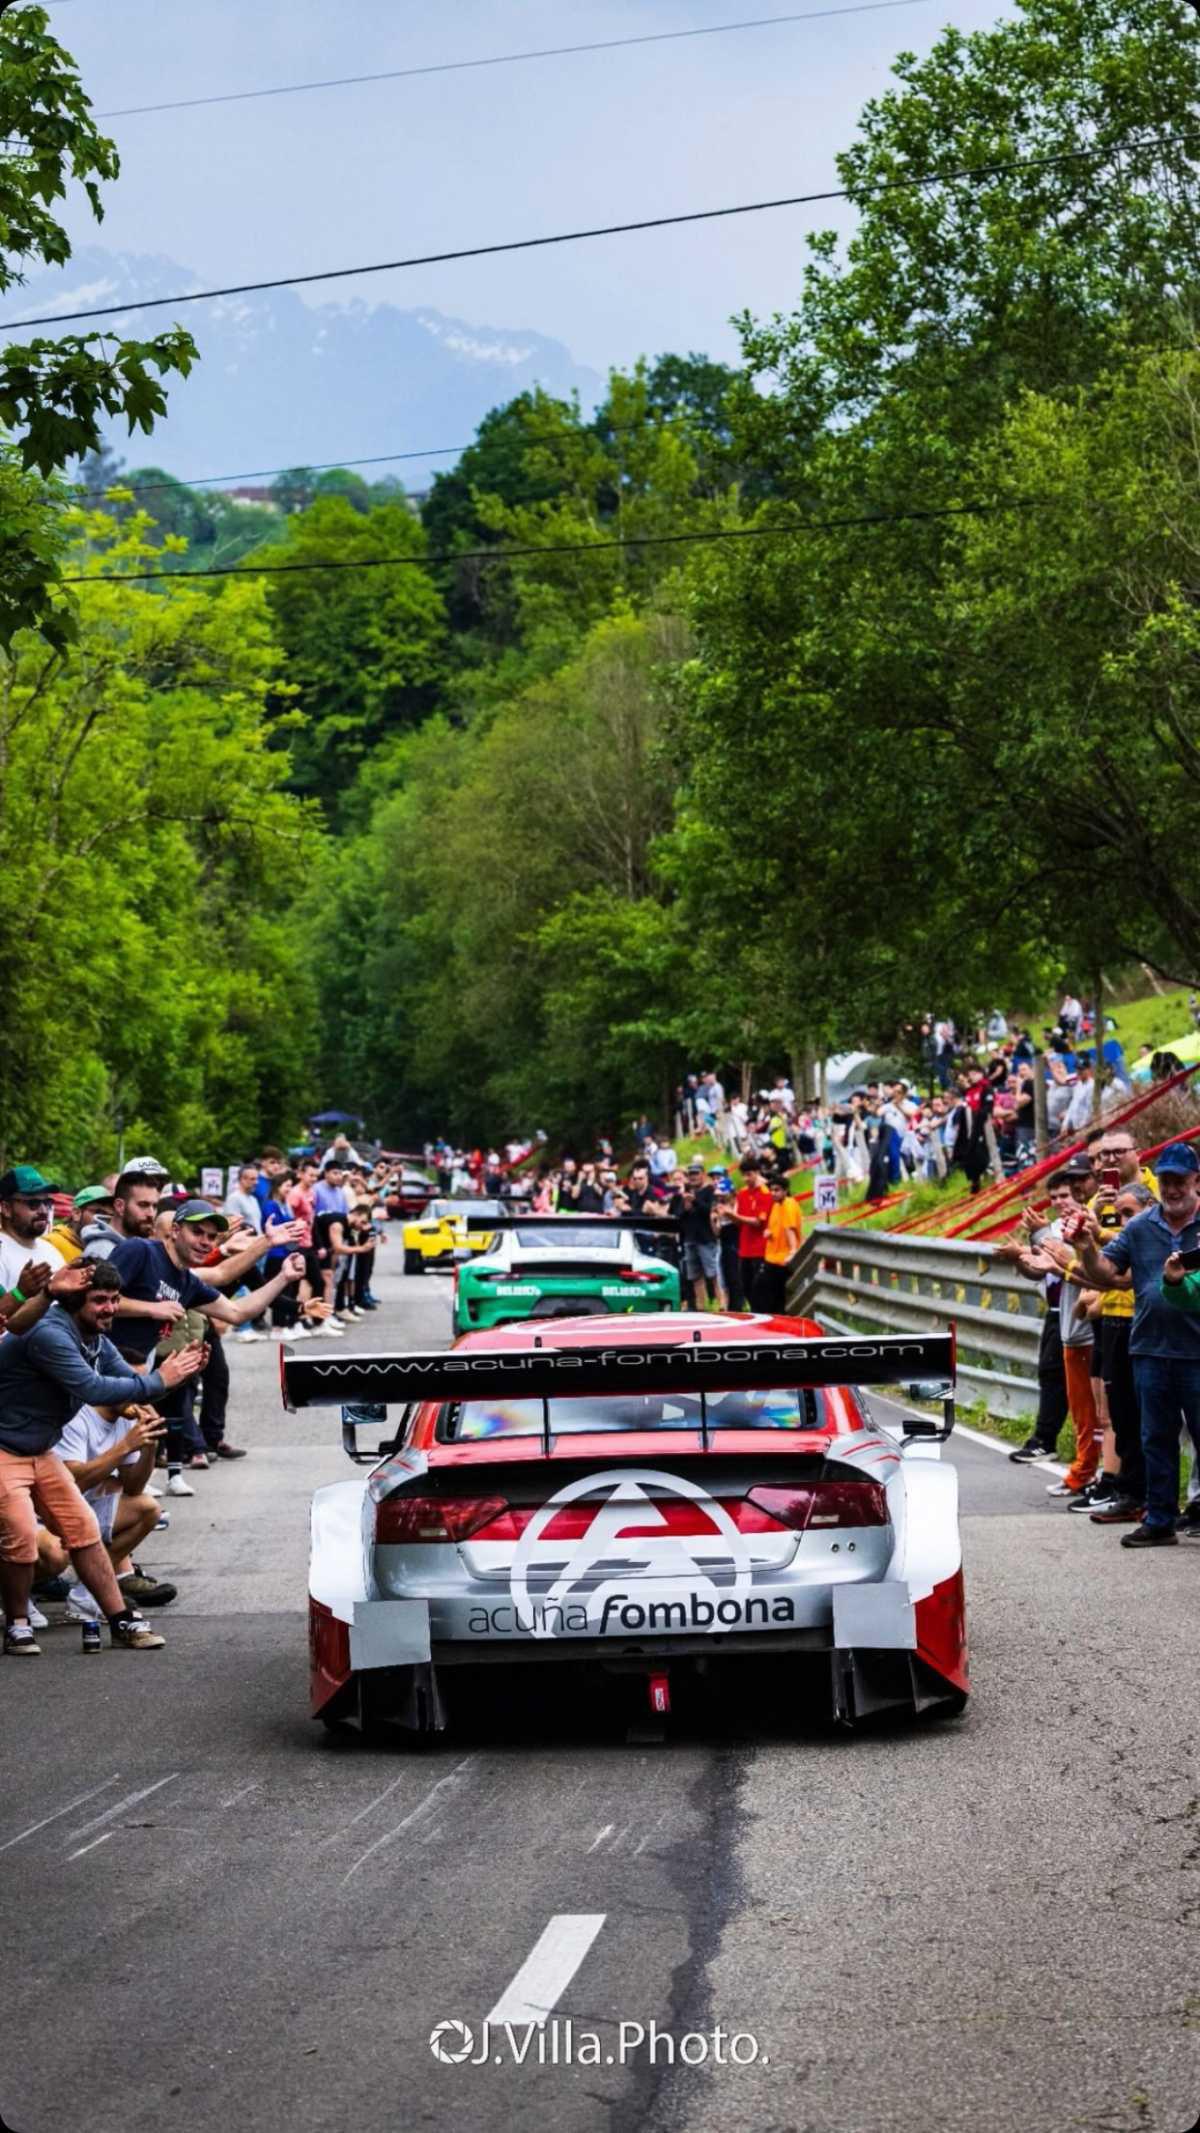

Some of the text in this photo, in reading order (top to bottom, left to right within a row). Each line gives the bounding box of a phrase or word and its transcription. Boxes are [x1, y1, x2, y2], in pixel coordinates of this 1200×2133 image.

[313, 1344, 924, 1376] www.acuna-fombona.com
[468, 1592, 795, 1634] acuña fombona
